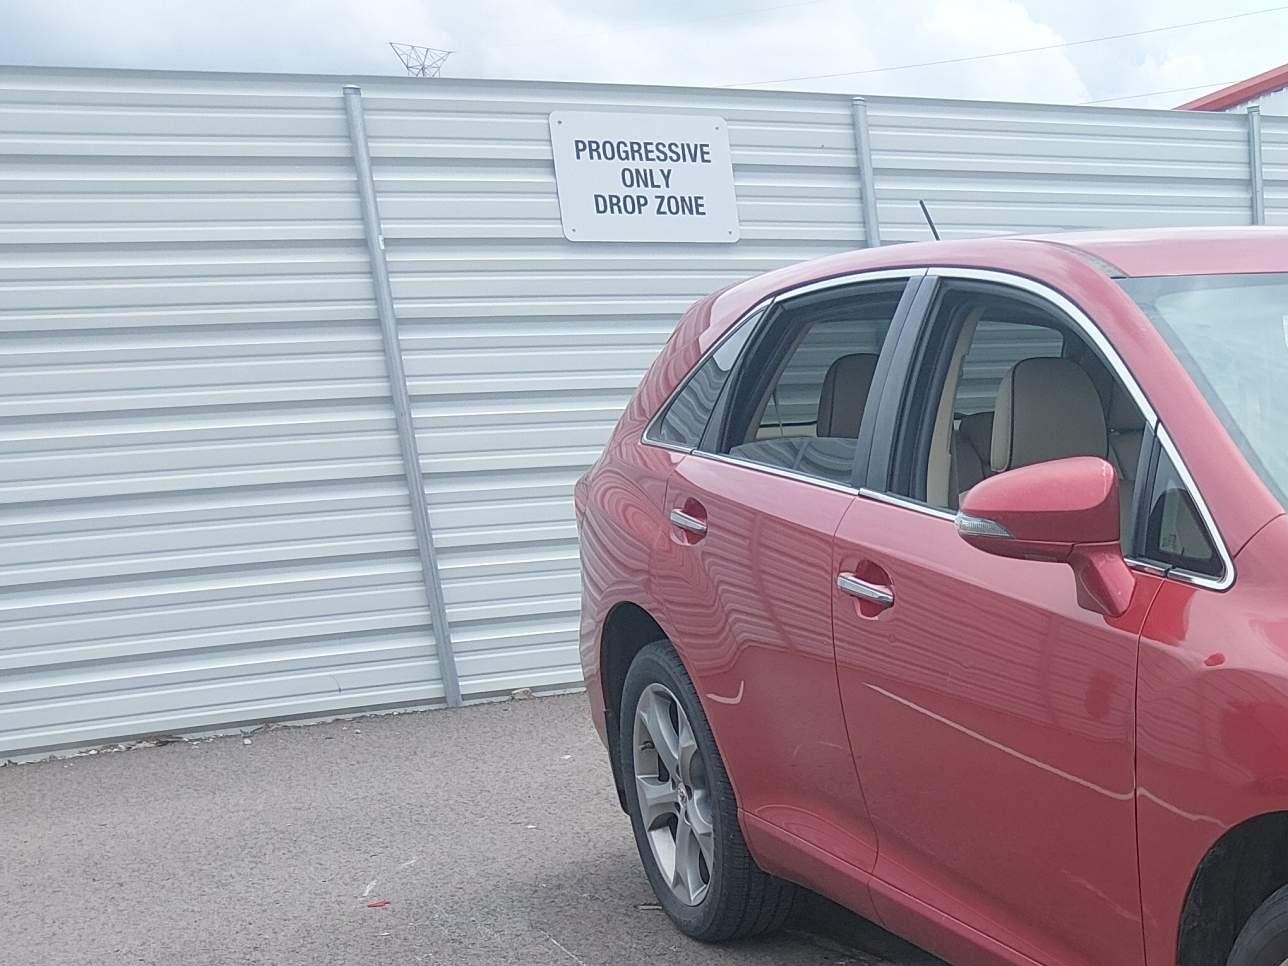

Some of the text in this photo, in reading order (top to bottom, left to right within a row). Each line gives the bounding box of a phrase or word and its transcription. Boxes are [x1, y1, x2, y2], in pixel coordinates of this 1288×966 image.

[574, 139, 712, 164] PROGRESSIVE
[621, 167, 672, 189] ONLY
[593, 194, 707, 216] DROP ZONE
